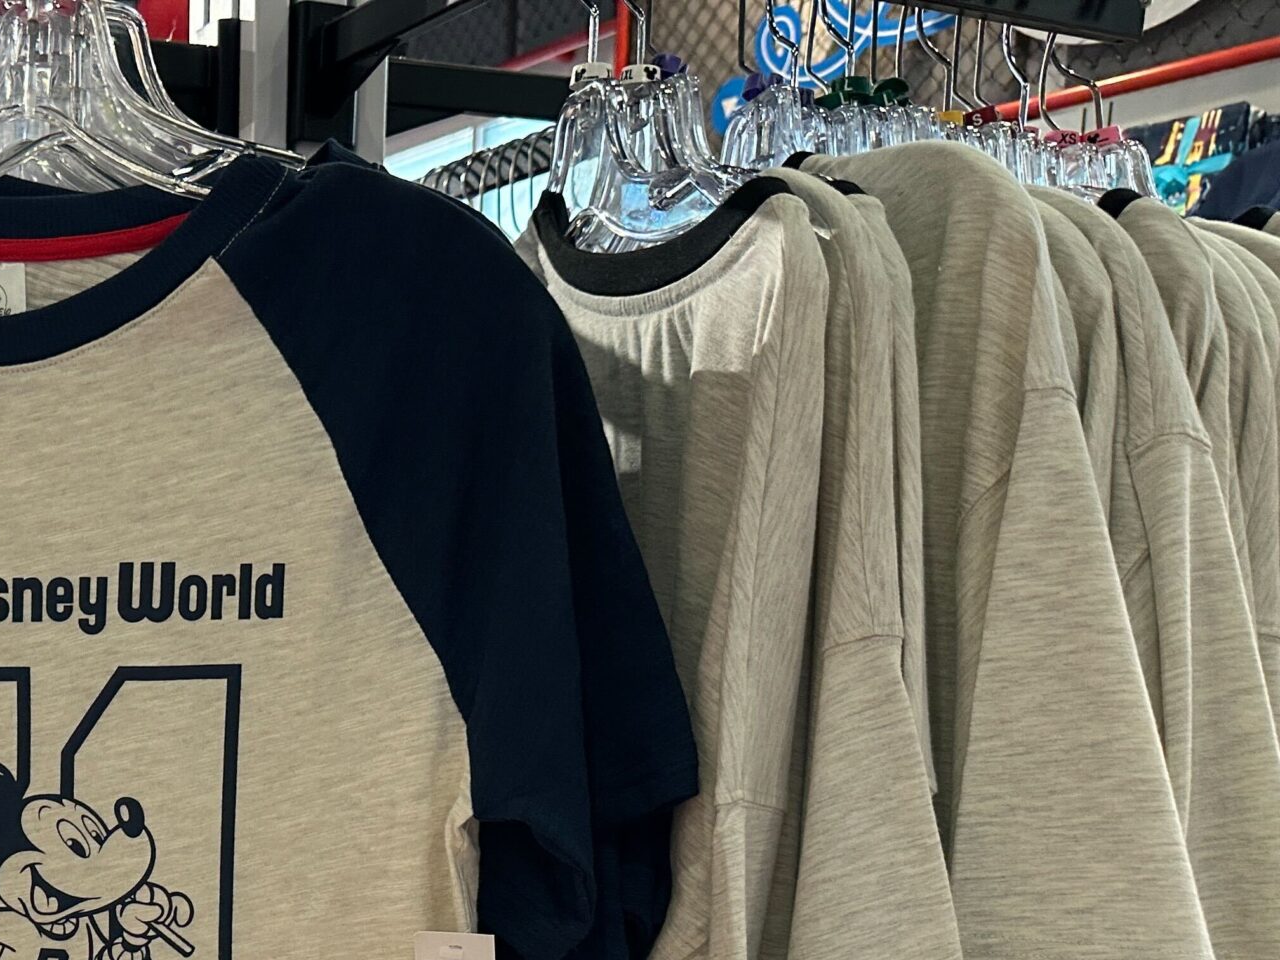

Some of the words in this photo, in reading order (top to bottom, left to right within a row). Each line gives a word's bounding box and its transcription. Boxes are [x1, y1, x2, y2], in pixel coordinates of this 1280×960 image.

[972, 113, 983, 126] S
[1059, 133, 1077, 144] XS
[118, 562, 286, 622] World
